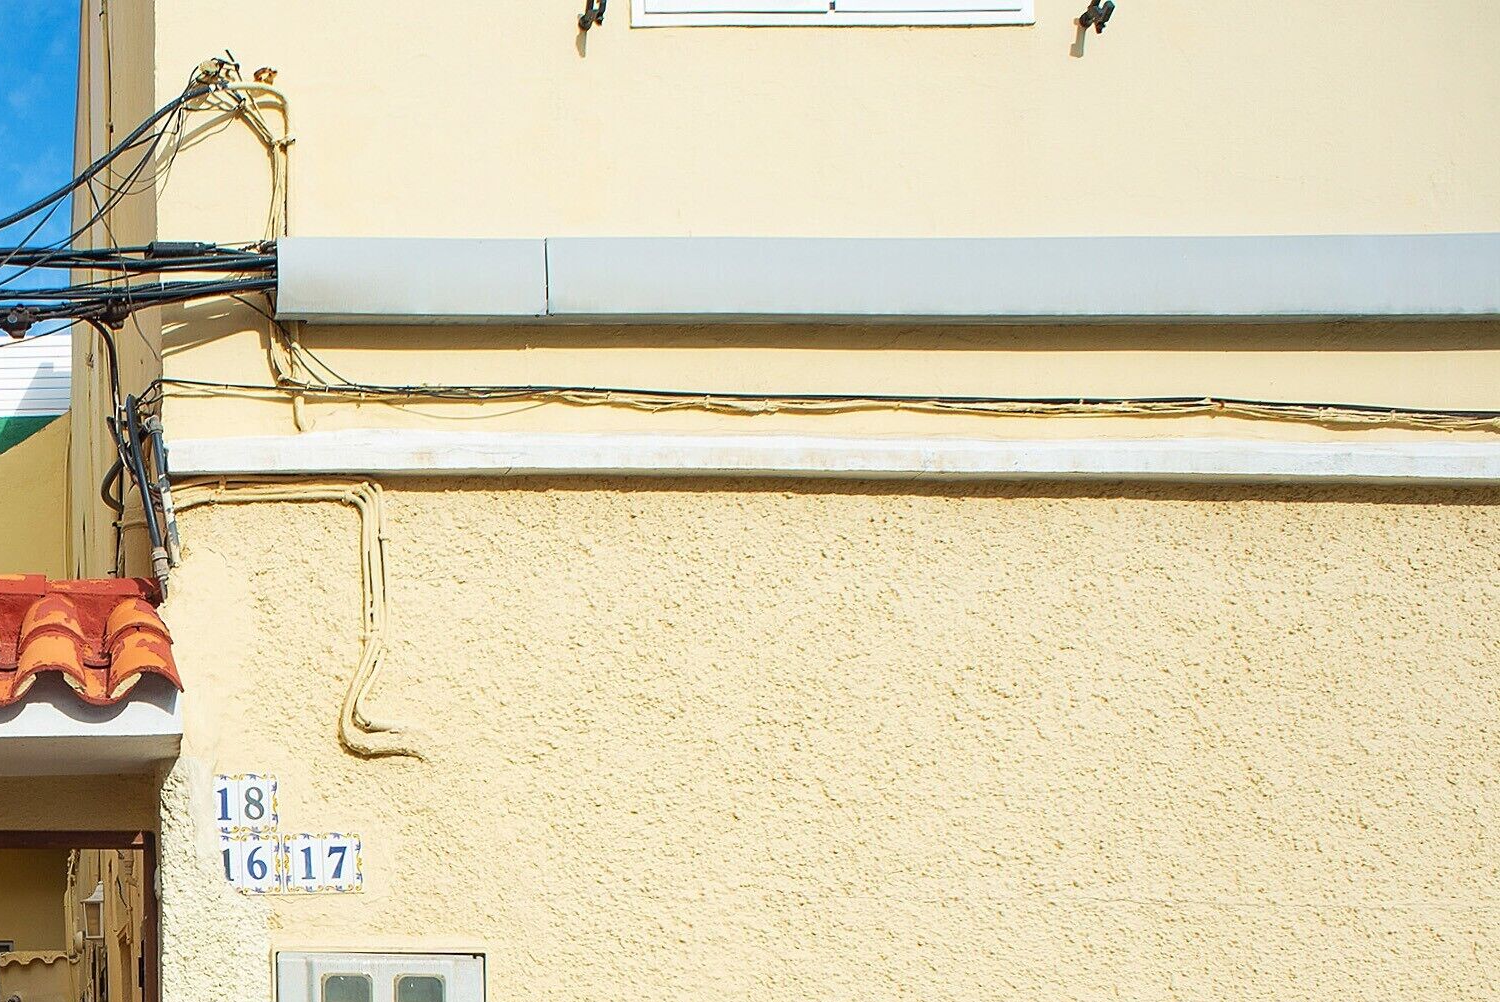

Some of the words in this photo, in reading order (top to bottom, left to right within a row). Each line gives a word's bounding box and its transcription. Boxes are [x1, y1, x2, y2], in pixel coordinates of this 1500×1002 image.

[217, 787, 264, 820] 18
[222, 846, 267, 881] 16
[301, 846, 347, 880] 17
